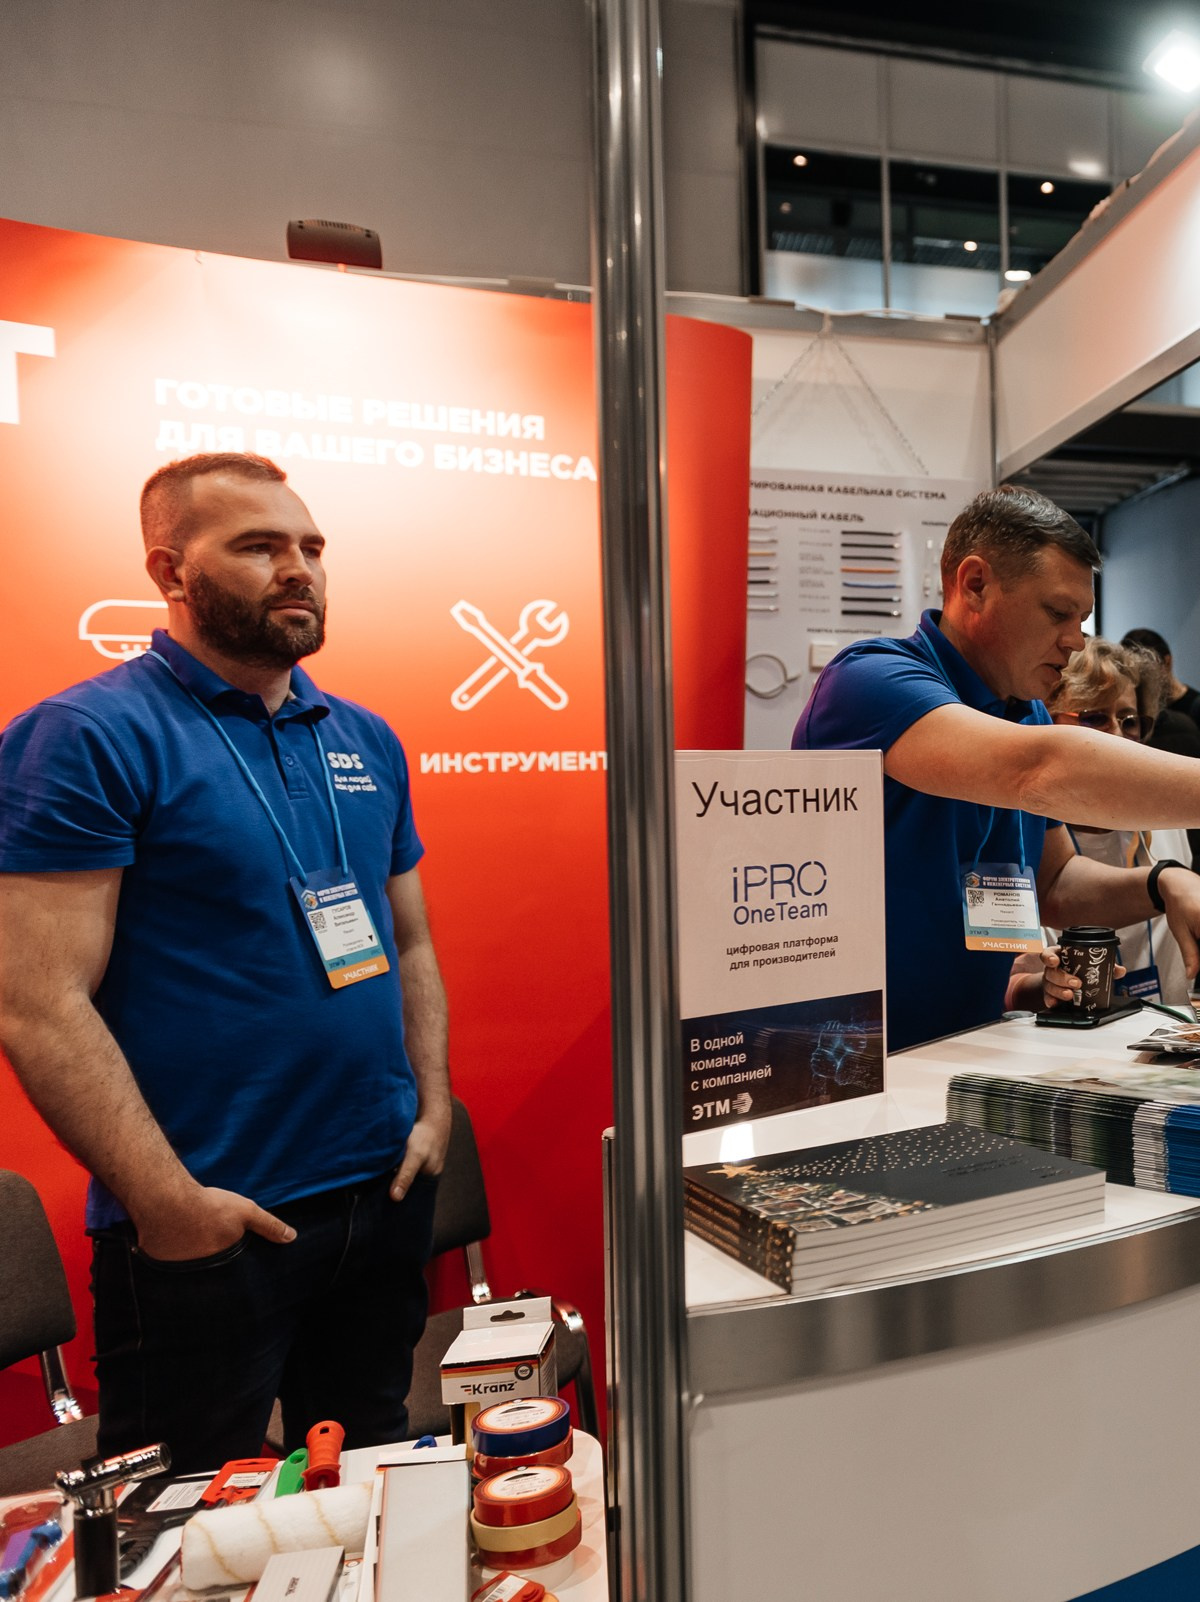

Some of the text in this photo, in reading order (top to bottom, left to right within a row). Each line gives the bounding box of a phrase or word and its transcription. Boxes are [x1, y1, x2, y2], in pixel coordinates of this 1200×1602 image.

[154, 378, 545, 441] ГОТОВЫЕ РЕШЕНИЯ
[155, 420, 598, 482] ДЛЯ ВАШЕГО БИЗНЕСА
[827, 485, 893, 498] КАБЕЛЬНАЯ
[896, 489, 947, 500] СИСТЕМА
[748, 508, 864, 523] АЦИОННЫЙ КАБЕЛЬ
[327, 751, 364, 770] SDS
[420, 751, 608, 774] ИНСТРУМЕНТ
[692, 781, 858, 818] Участник
[732, 860, 828, 904] iPRO
[733, 901, 828, 925] OneTeam
[726, 934, 839, 957] цифровая платформа
[982, 941, 1028, 950] УЧАСТНИК
[1073, 949, 1085, 957] Tea
[729, 947, 836, 971] для производителей
[343, 964, 379, 981] УЧАСТНИК
[690, 1031, 744, 1052] В одной
[690, 1052, 747, 1072] команде
[690, 1065, 772, 1092] с компанией
[691, 1098, 730, 1121] ЭТМ
[472, 1382, 516, 1395] Kranz
